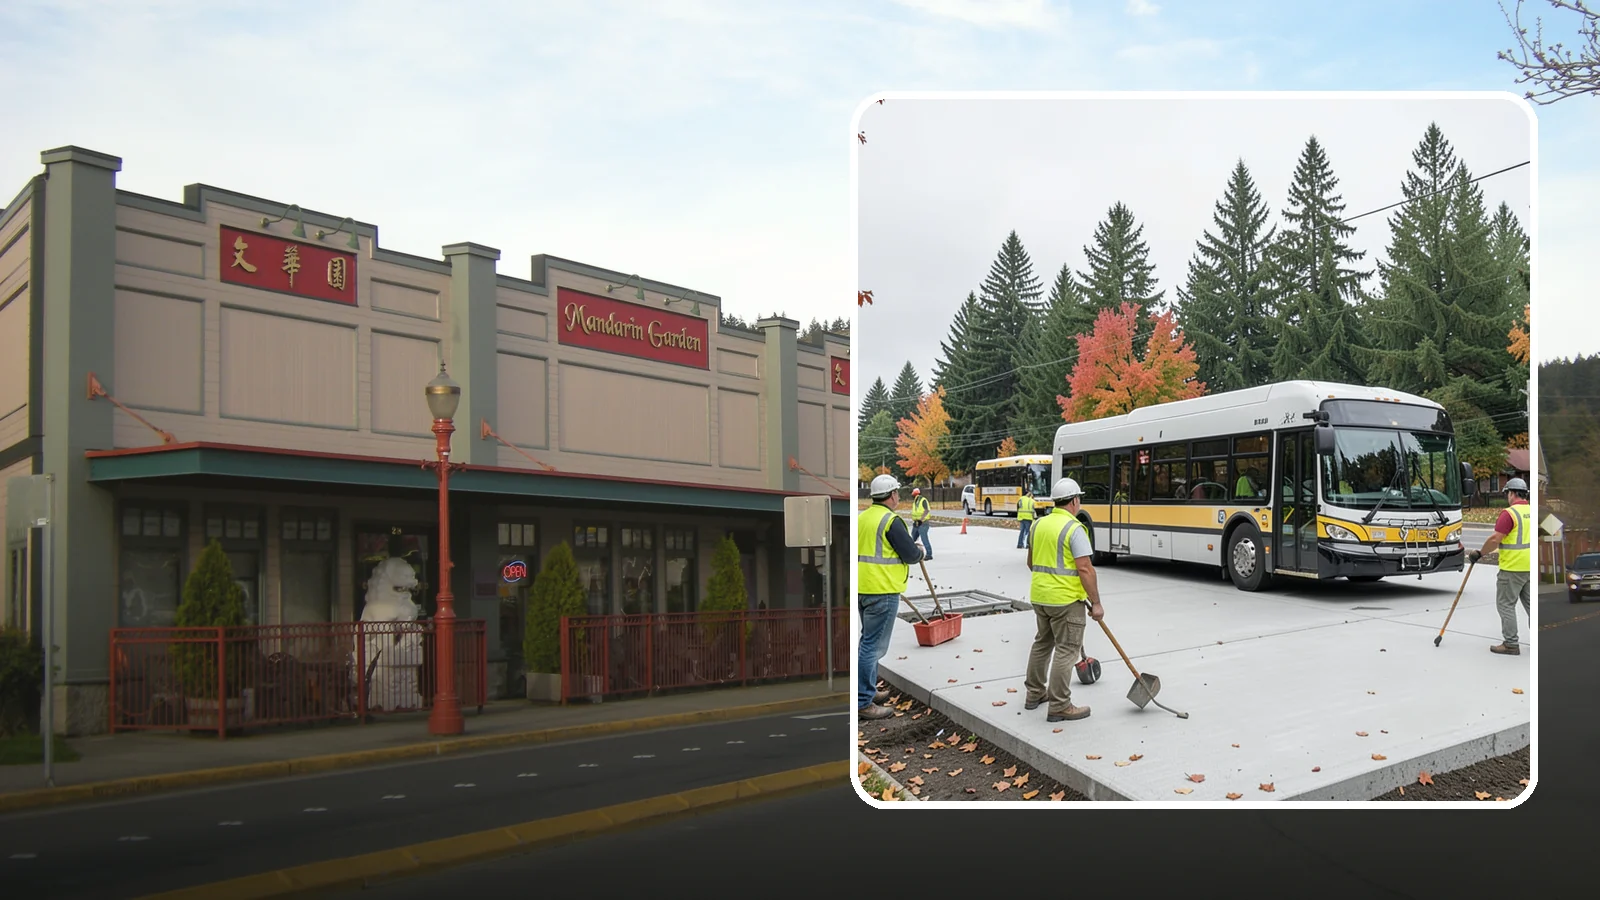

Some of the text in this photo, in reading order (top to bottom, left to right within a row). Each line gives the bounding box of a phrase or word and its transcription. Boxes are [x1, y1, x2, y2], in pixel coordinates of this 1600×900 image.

[564, 302, 702, 352] Mandarin Garden
[503, 565, 527, 578] OPEN
